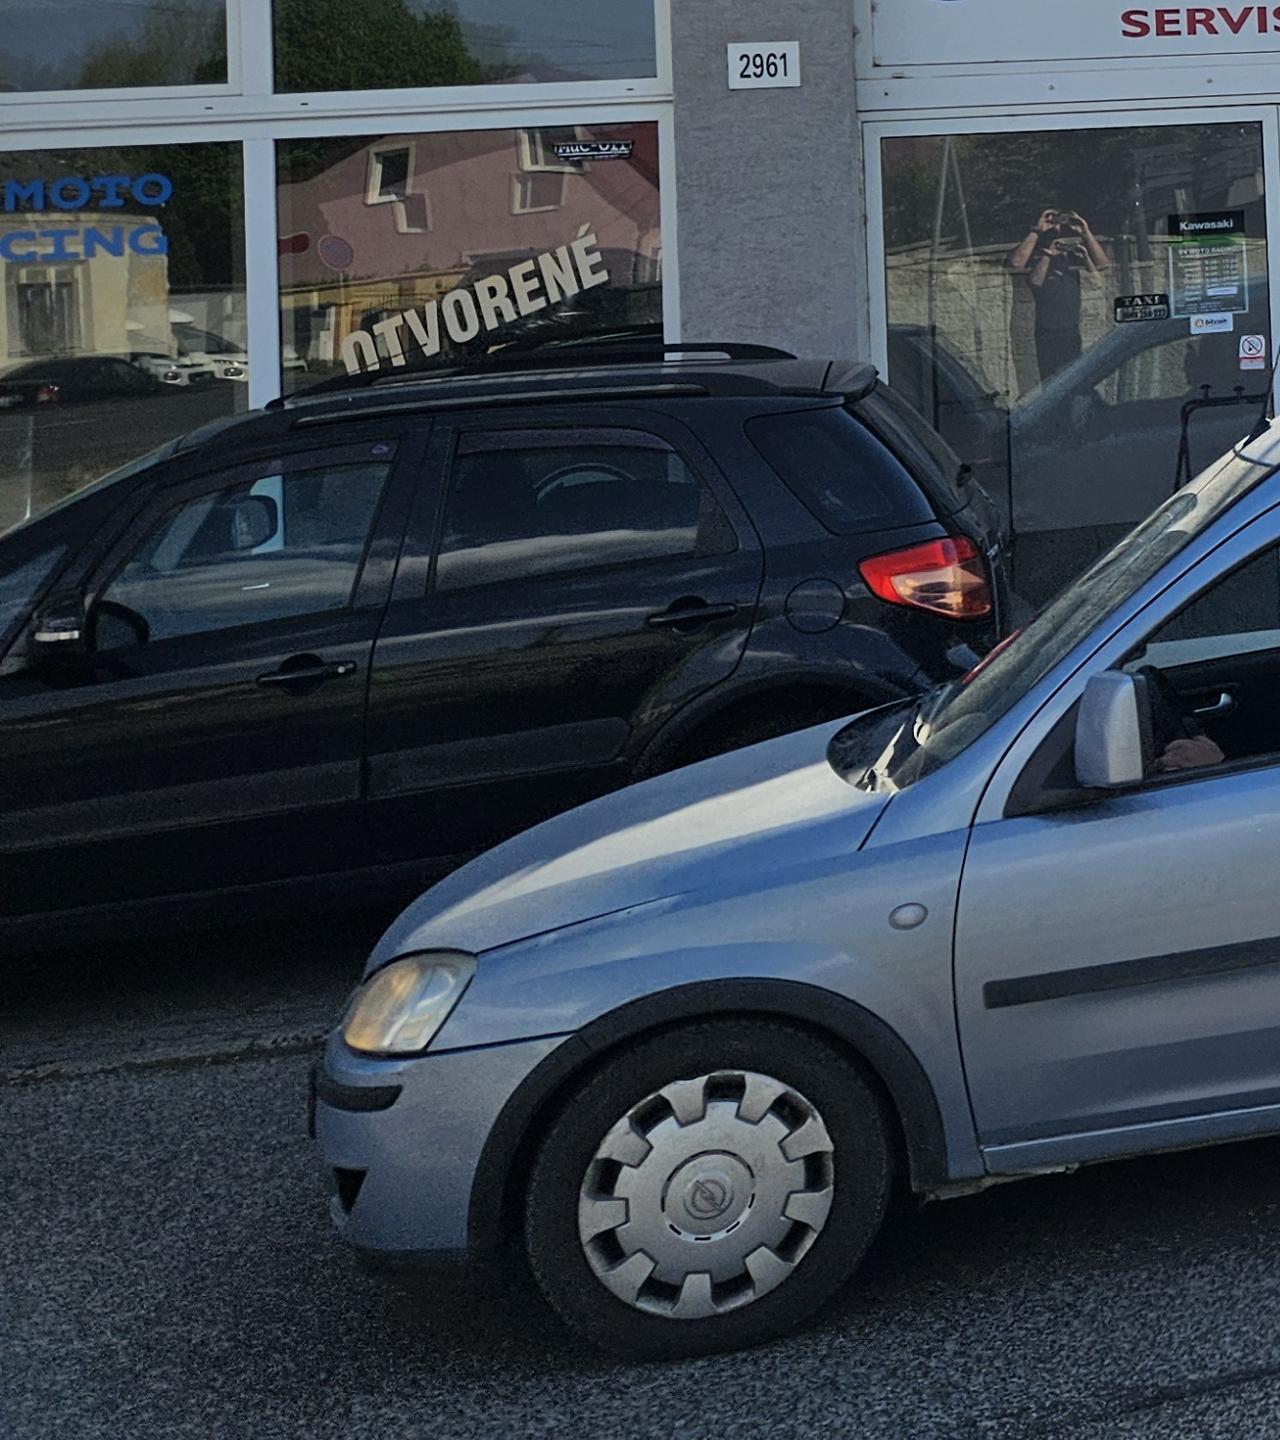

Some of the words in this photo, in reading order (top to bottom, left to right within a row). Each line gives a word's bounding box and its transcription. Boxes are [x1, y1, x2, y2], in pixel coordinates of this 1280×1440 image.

[738, 51, 790, 80] 2961
[3, 172, 174, 213] MOTO
[1179, 218, 1234, 231] Kawasaki
[0, 222, 169, 263] CING
[340, 222, 609, 376] OTVORENÉ
[1123, 295, 1161, 306] TAXI
